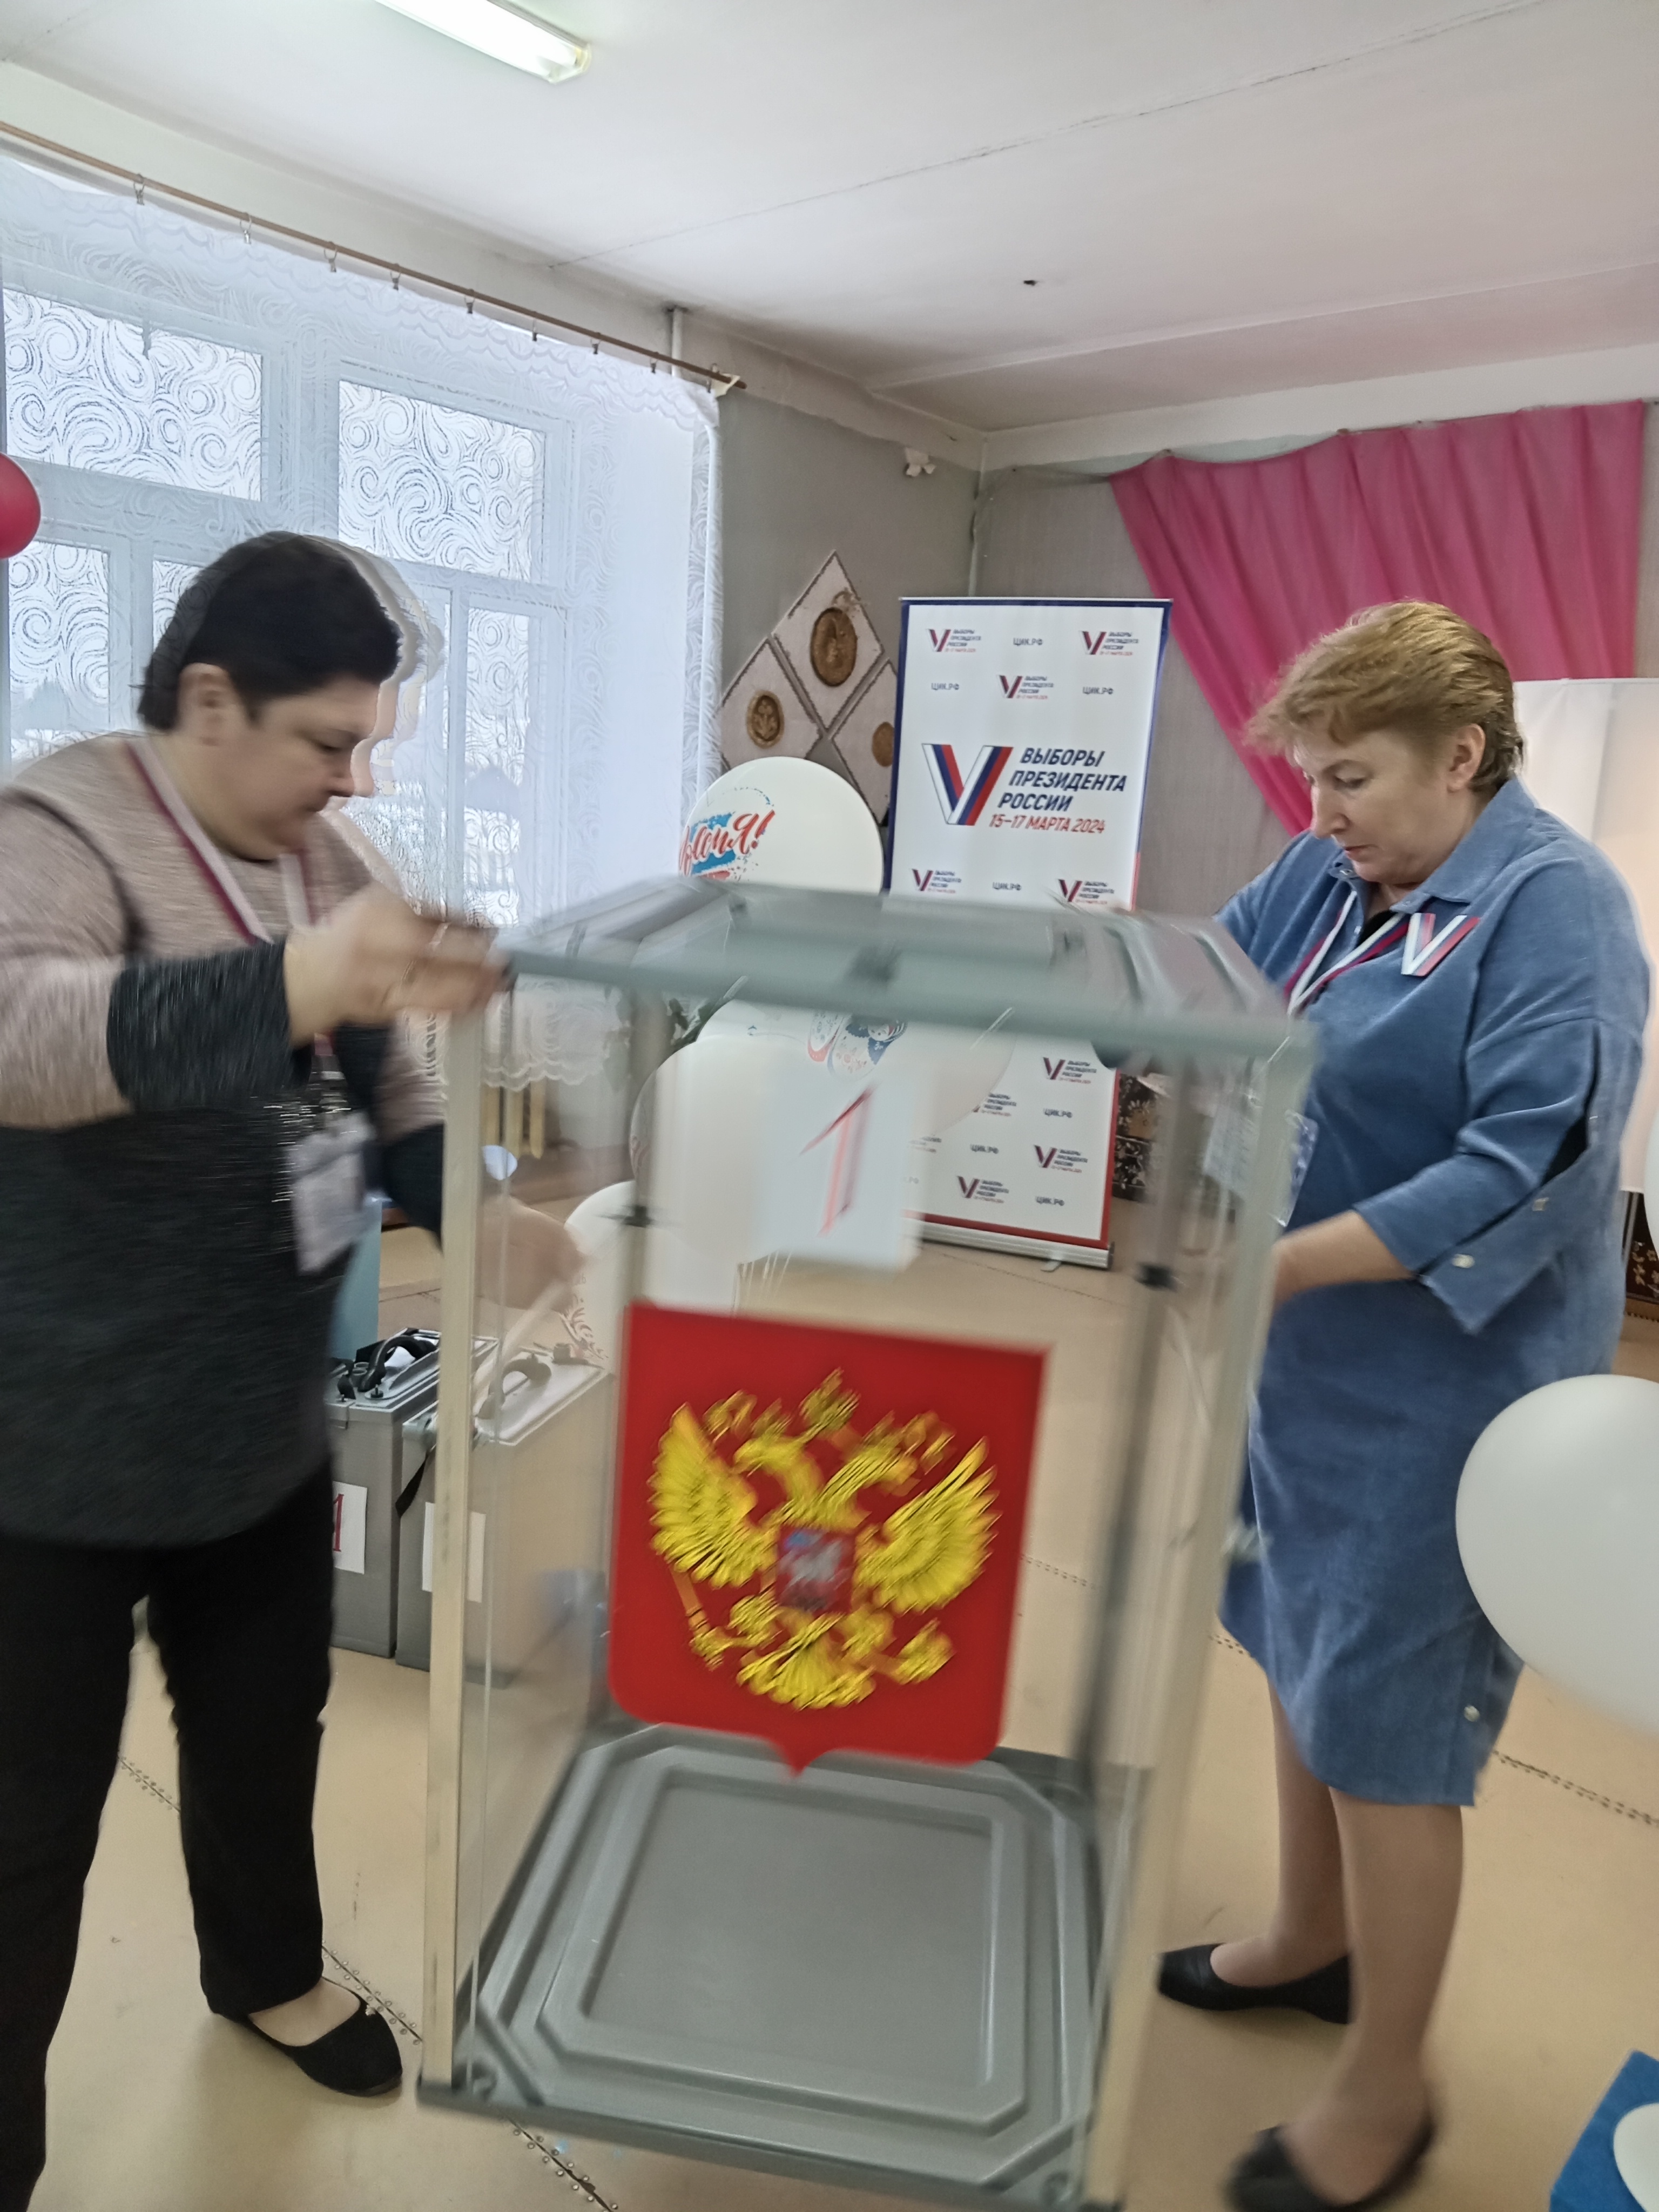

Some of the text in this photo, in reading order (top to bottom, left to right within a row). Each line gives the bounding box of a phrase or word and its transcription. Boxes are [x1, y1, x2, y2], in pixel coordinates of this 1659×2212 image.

[1013, 638, 1043, 646] ЦИК.РФ
[1020, 747, 1105, 767] ВЫБОРЫ
[1008, 770, 1127, 792] ПРЕЗИДЕНТА
[997, 792, 1074, 812] РОССИИ
[1025, 815, 1071, 831] МАРТА
[1071, 818, 1105, 833] 2024
